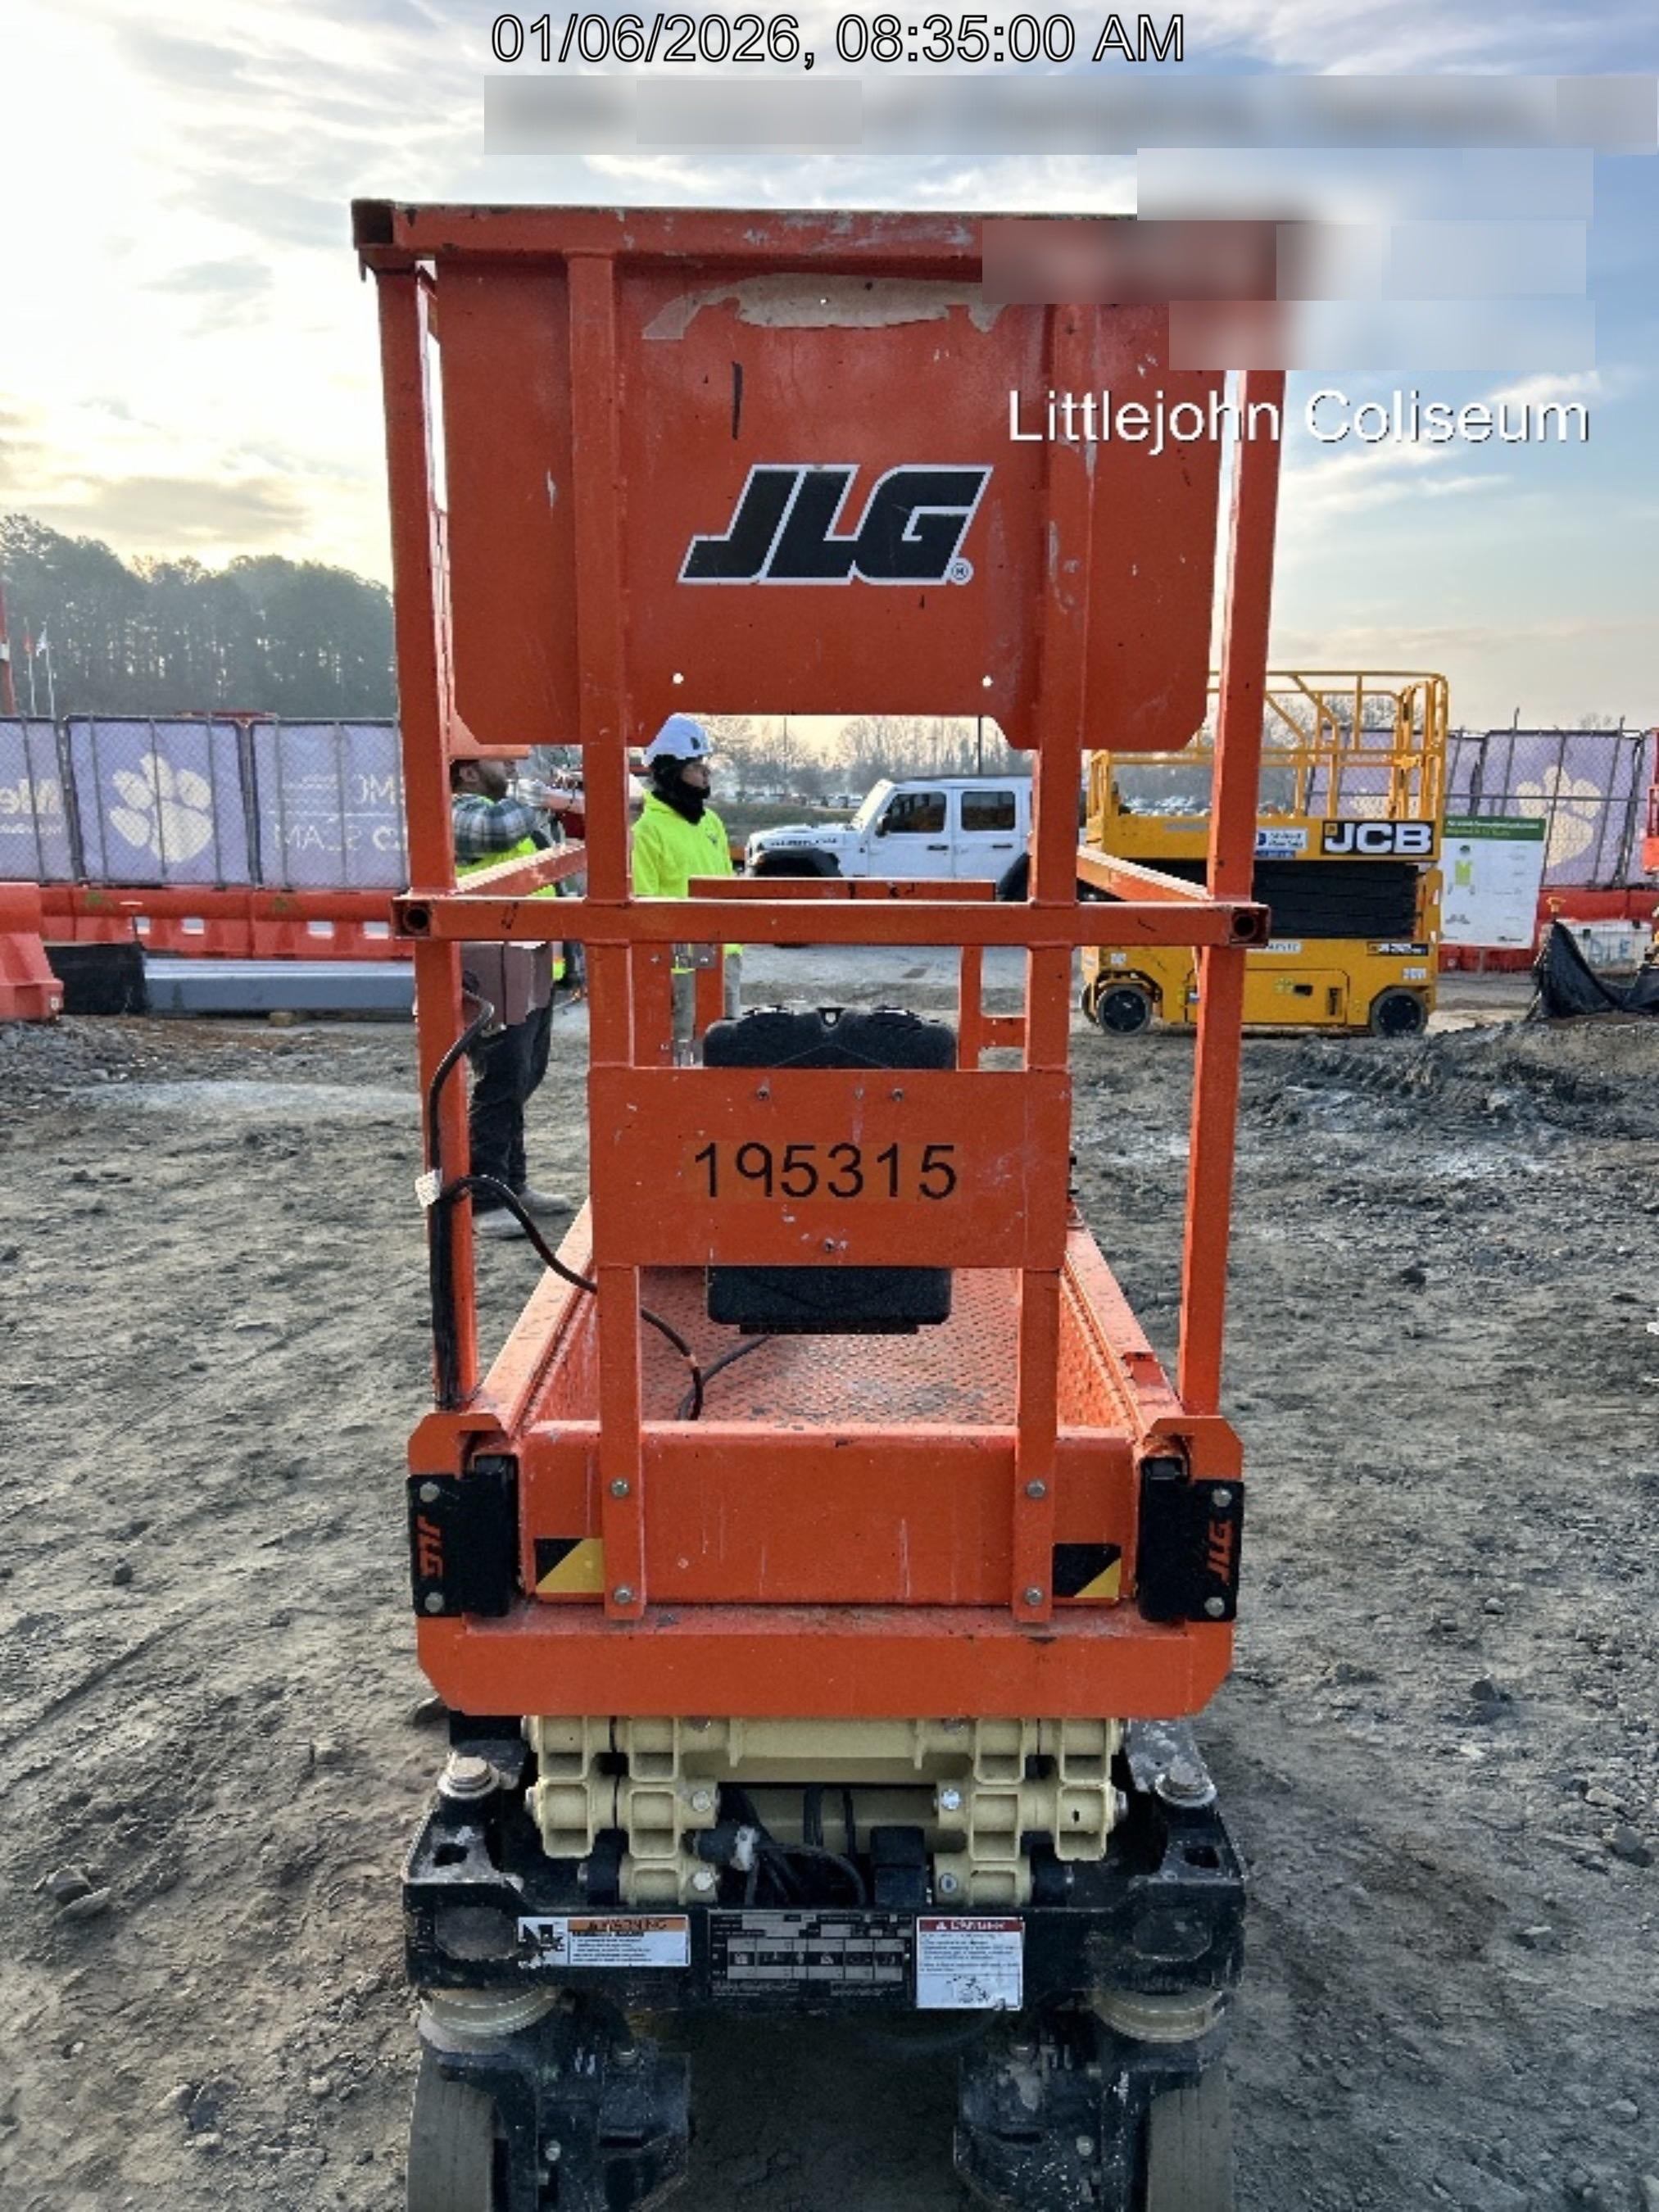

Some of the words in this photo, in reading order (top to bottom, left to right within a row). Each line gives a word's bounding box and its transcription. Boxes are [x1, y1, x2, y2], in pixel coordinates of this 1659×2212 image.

[678, 464, 994, 586] JLG
[1324, 823, 1431, 854] JCB
[694, 1141, 958, 1199] 195315
[416, 1515, 443, 1579] JLG
[1207, 1519, 1233, 1586] JLG
